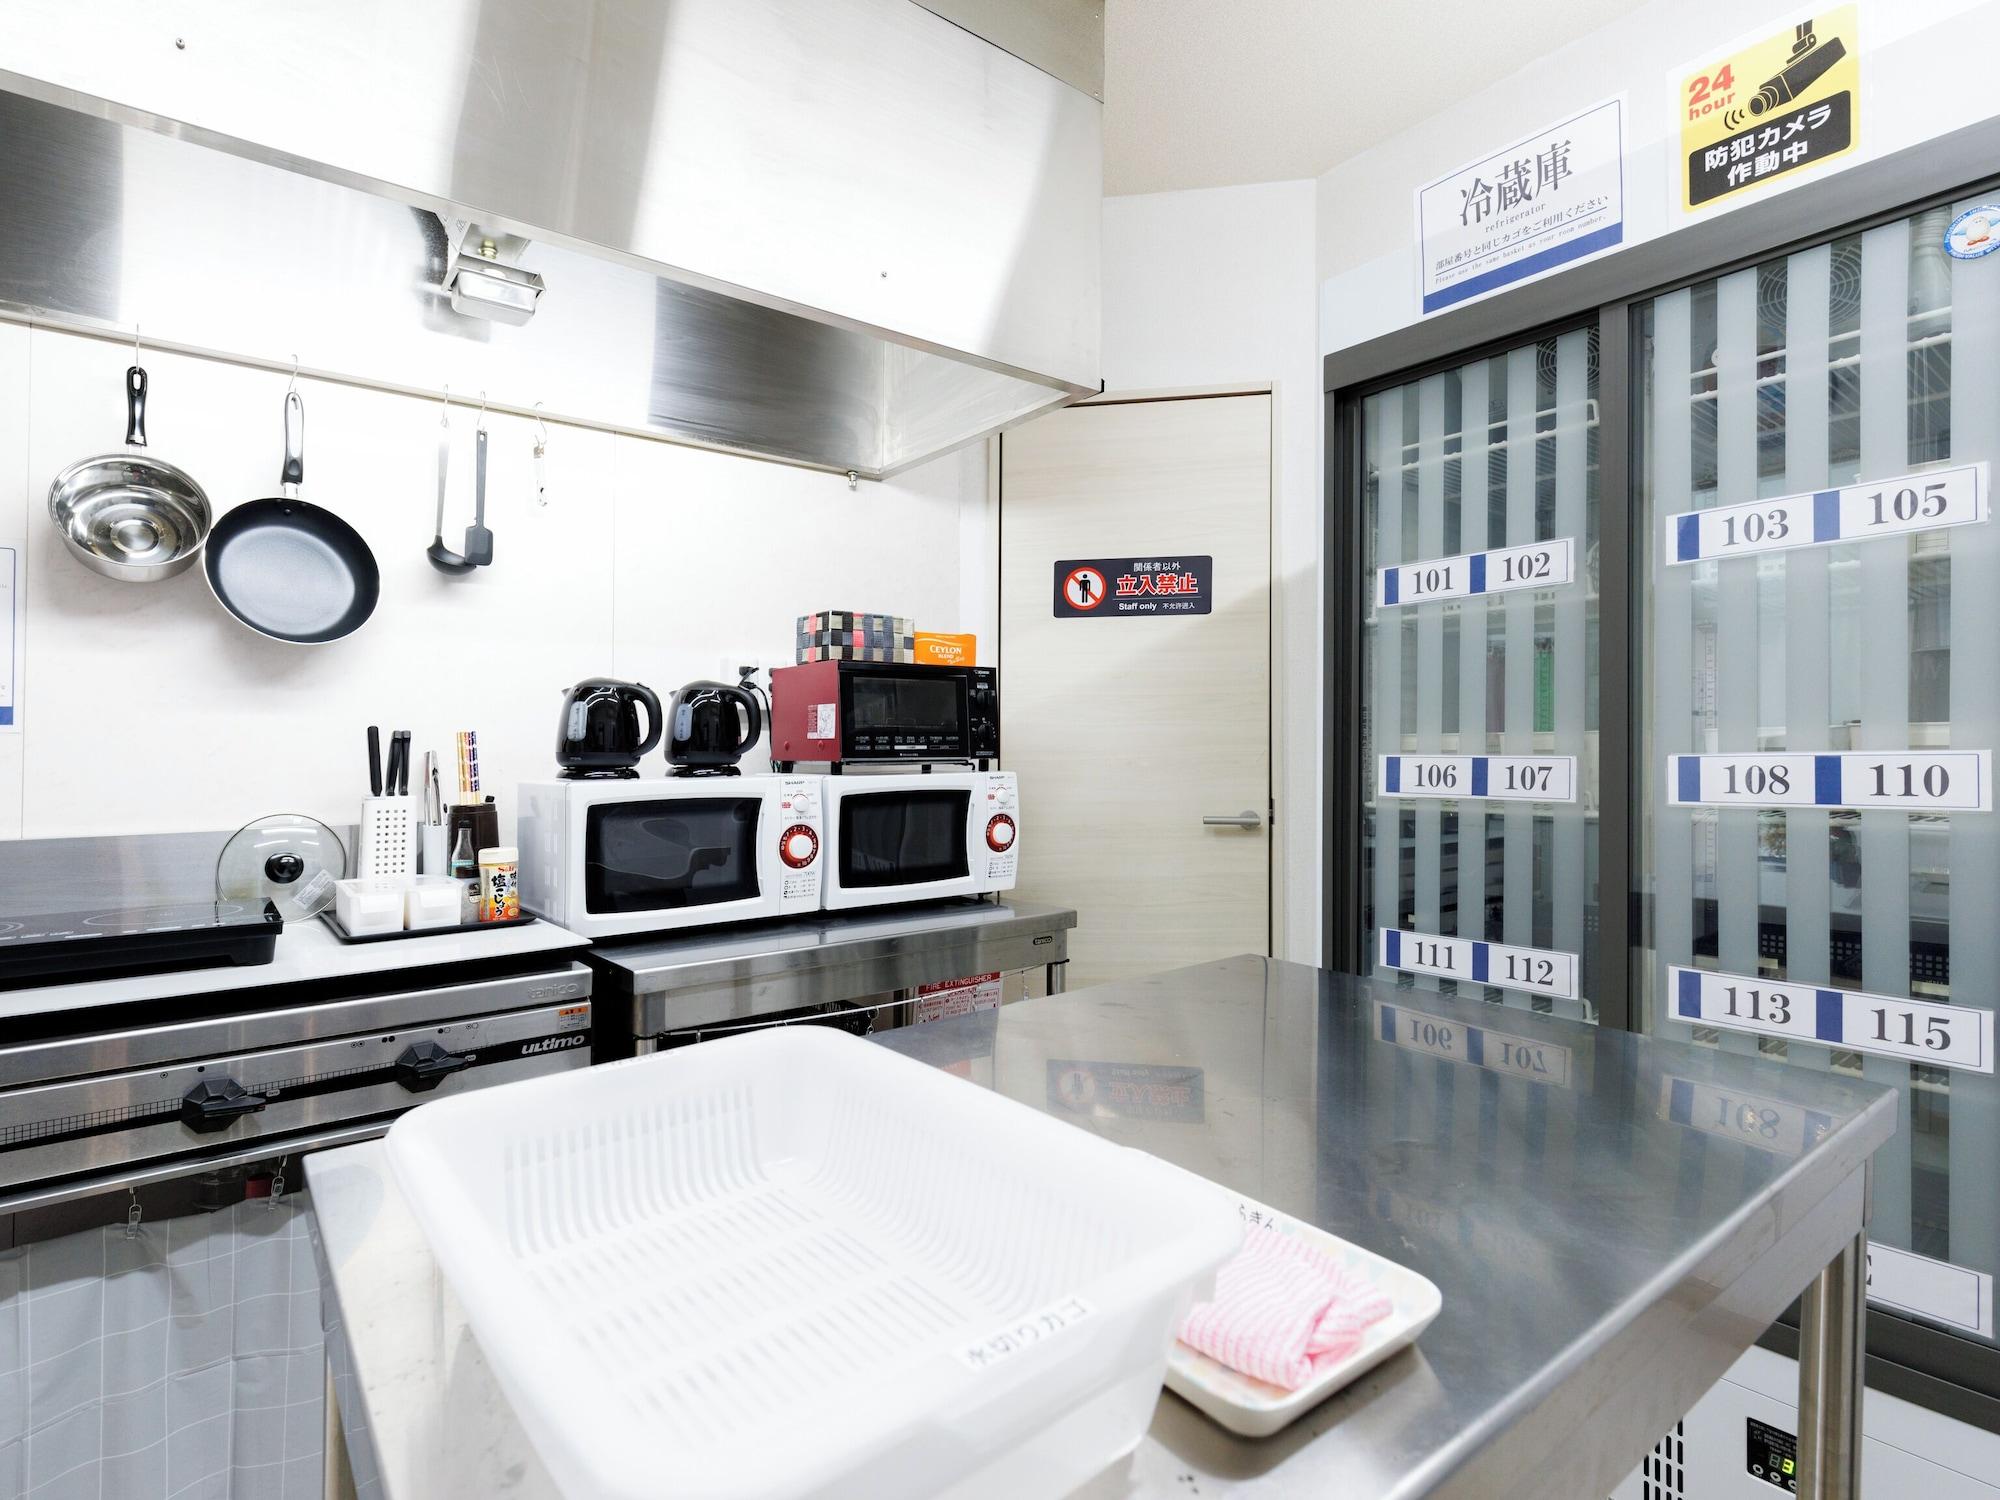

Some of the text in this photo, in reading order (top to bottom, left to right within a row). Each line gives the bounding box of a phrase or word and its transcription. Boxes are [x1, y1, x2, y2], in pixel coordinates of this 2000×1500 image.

[1688, 64, 1735, 107] 24
[1689, 92, 1735, 121] hour
[1704, 104, 1832, 172] 防犯カメラ
[1727, 140, 1809, 187] 作動中
[1459, 140, 1573, 226] 冷蔵庫
[1485, 203, 1547, 233] refrigerator
[1503, 246, 1525, 258] basket
[1721, 482, 1949, 547] 103 105
[1133, 561, 1181, 572] 関係者以外
[1412, 552, 1552, 595] 101 102
[1116, 572, 1199, 596] 立入禁止
[1118, 602, 1157, 612] Staff only
[929, 645, 962, 655] CEYLON
[1414, 763, 1553, 792] 106 107
[1722, 763, 1950, 798] 108 110
[491, 873, 507, 916] 塩こしょう
[1414, 941, 1554, 987] 111 112
[925, 974, 993, 992] FIRE EXTINGUISHER
[1723, 986, 1952, 1051] 113 115
[521, 1034, 585, 1055] ultimo
[1782, 1458, 1795, 1475] 3
